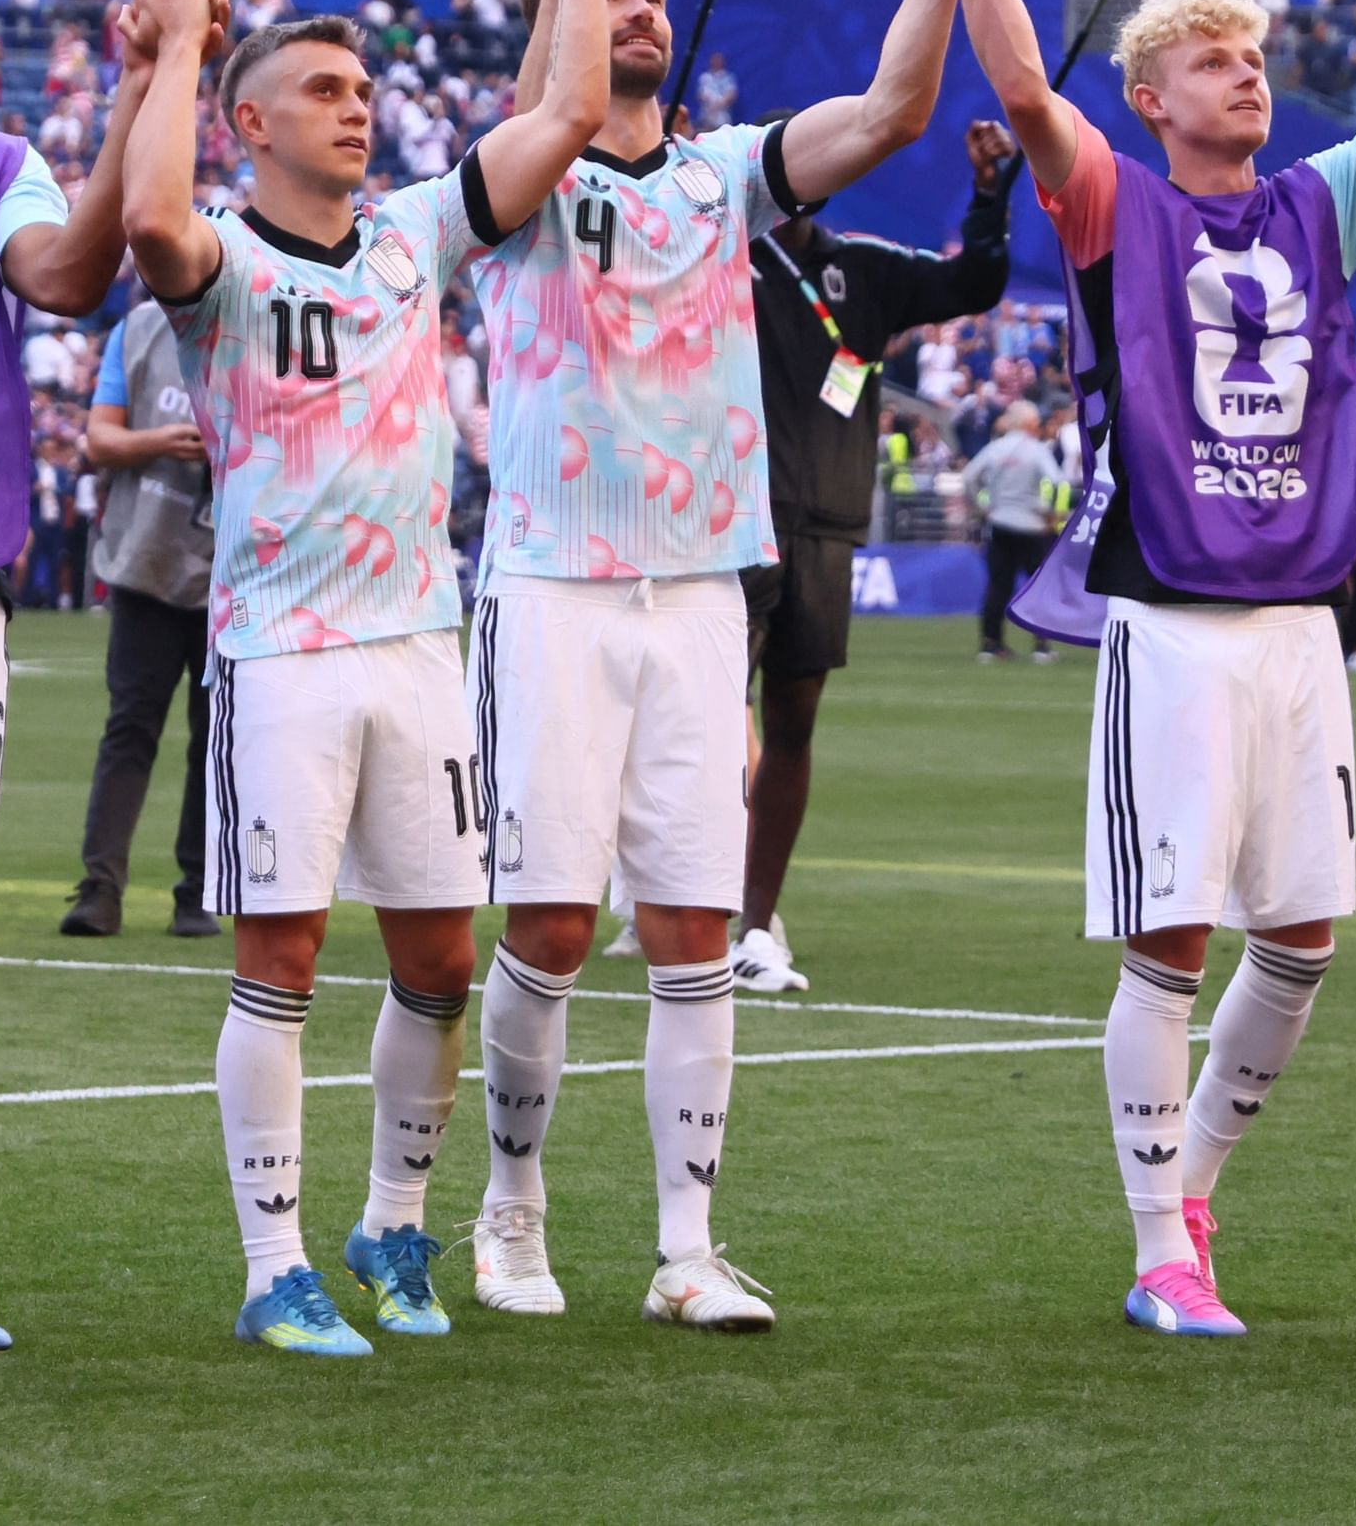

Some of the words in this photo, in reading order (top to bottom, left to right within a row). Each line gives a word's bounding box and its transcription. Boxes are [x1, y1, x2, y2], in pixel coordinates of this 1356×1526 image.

[576, 197, 617, 276] 4
[270, 299, 340, 380] 10
[1219, 393, 1284, 416] FIFA
[1191, 439, 1270, 465] WORLD
[1193, 465, 1307, 500] 2026
[487, 1082, 546, 1110] RBFA
[1124, 1102, 1180, 1117] RBFA
